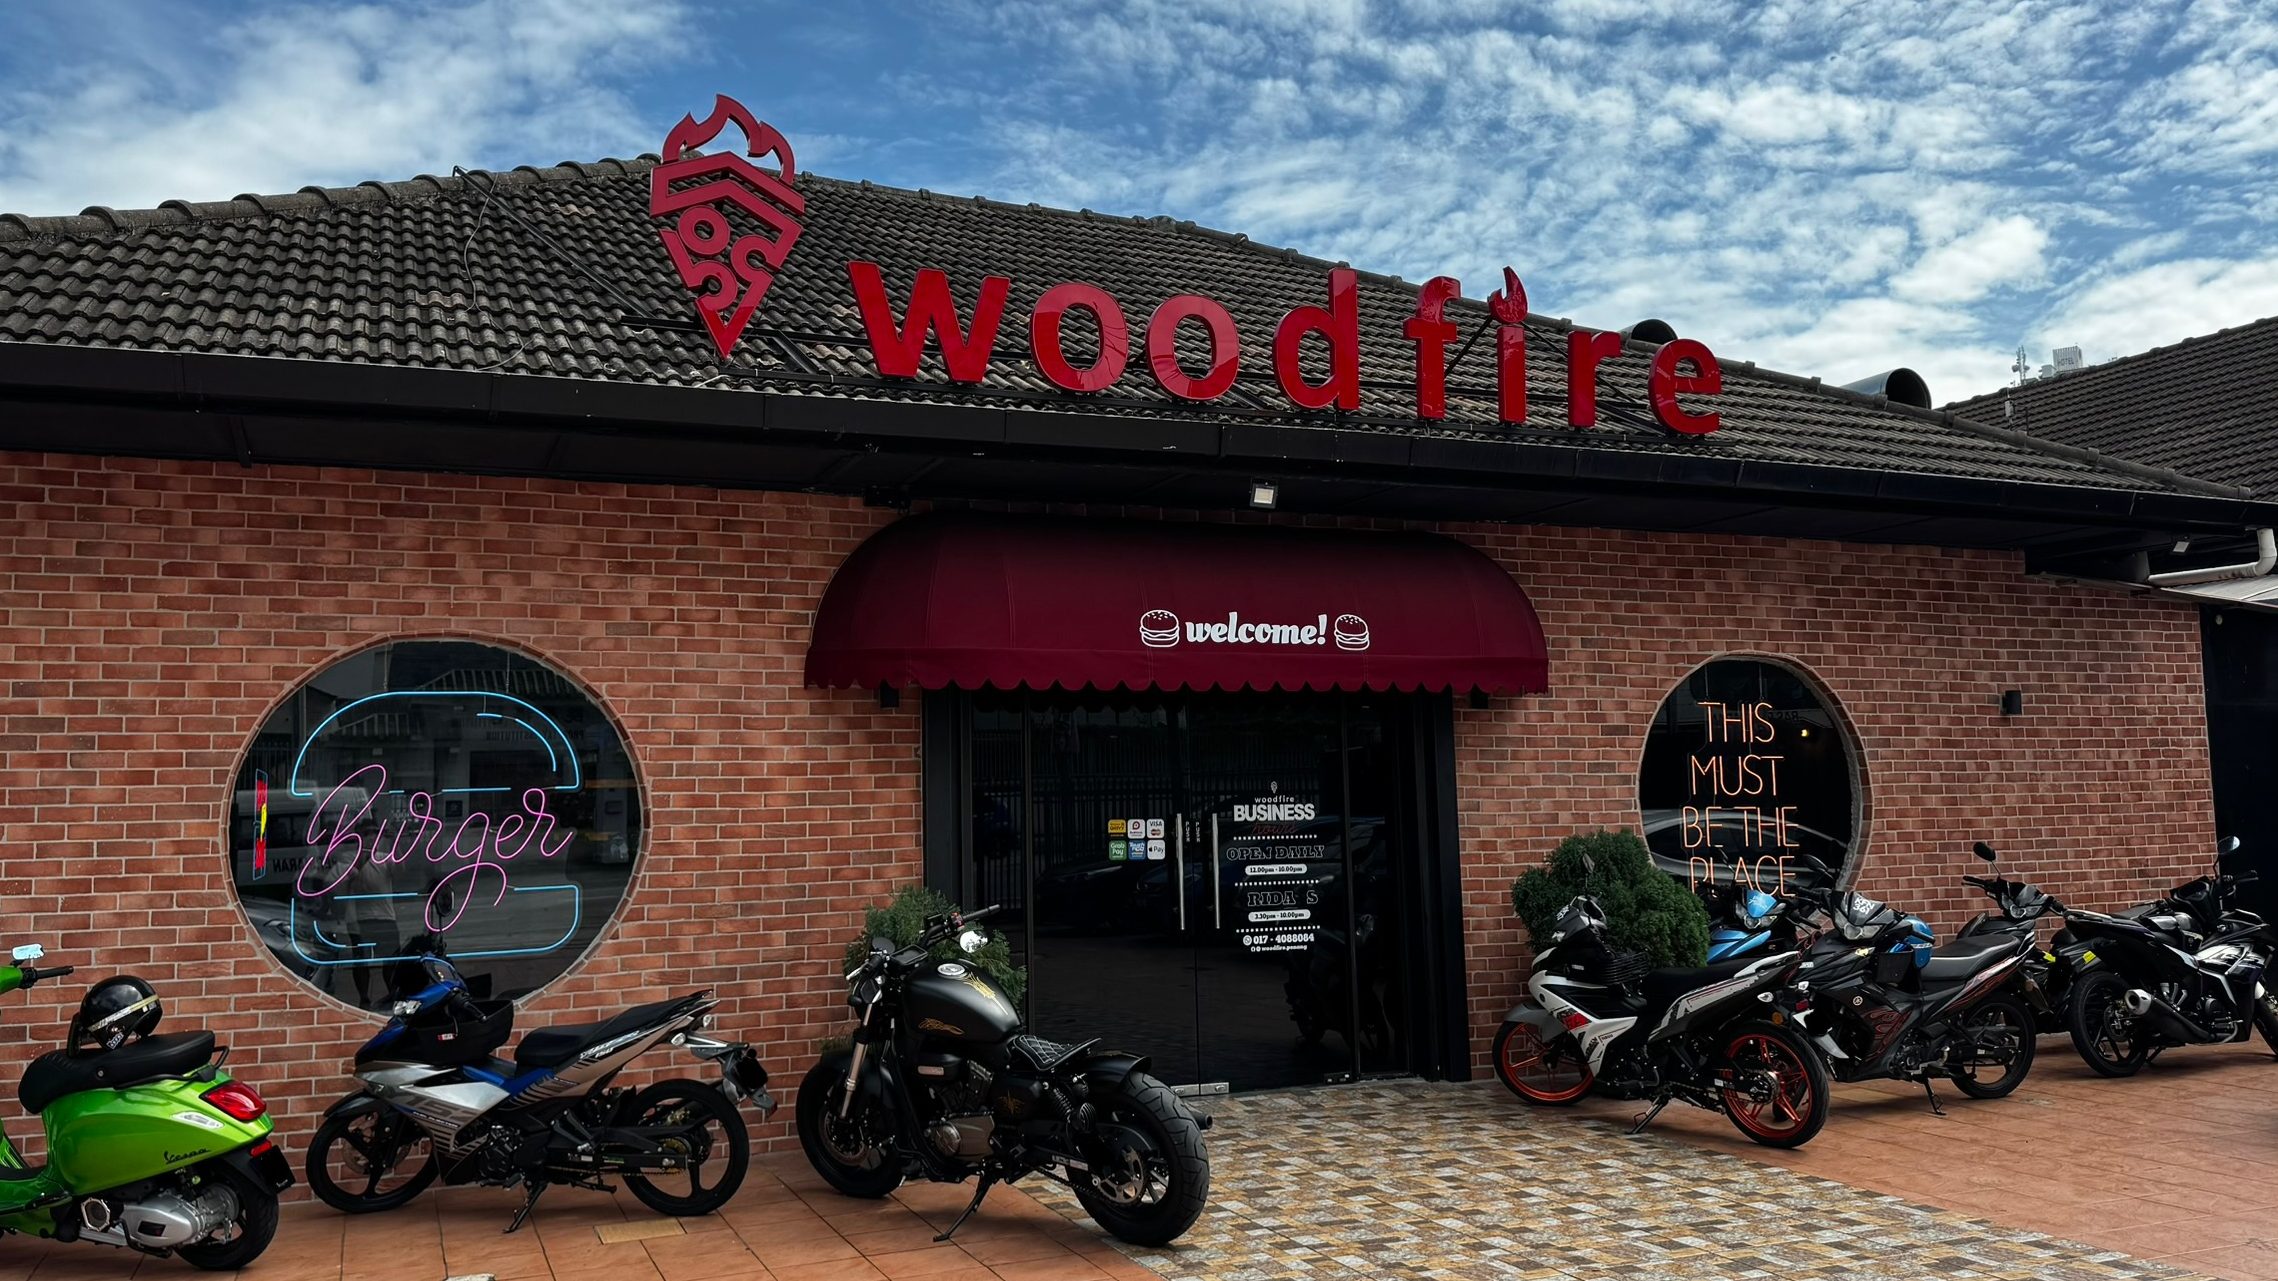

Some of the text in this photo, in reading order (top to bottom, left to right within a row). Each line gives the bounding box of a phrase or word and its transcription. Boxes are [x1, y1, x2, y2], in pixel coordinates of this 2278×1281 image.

[847, 261, 1722, 435] woodfire
[1185, 611, 1328, 645] welcome!
[1697, 701, 1775, 743] THIS
[1691, 754, 1784, 796] MUST
[1254, 795, 1295, 803] woodfire
[1233, 803, 1316, 822] BUSINESS
[1682, 805, 1799, 848] BE THE
[296, 763, 574, 933] Burger
[1153, 846, 1164, 854] Pay
[1226, 845, 1325, 861] OPEN DAILY
[1278, 865, 1303, 873] 10.00pm
[1689, 854, 1797, 897] PLACE
[1280, 910, 1305, 919] 10.00pm
[1253, 935, 1269, 945] 017
[1275, 932, 1315, 944] 4088084
[163, 1147, 212, 1166] Vespa
